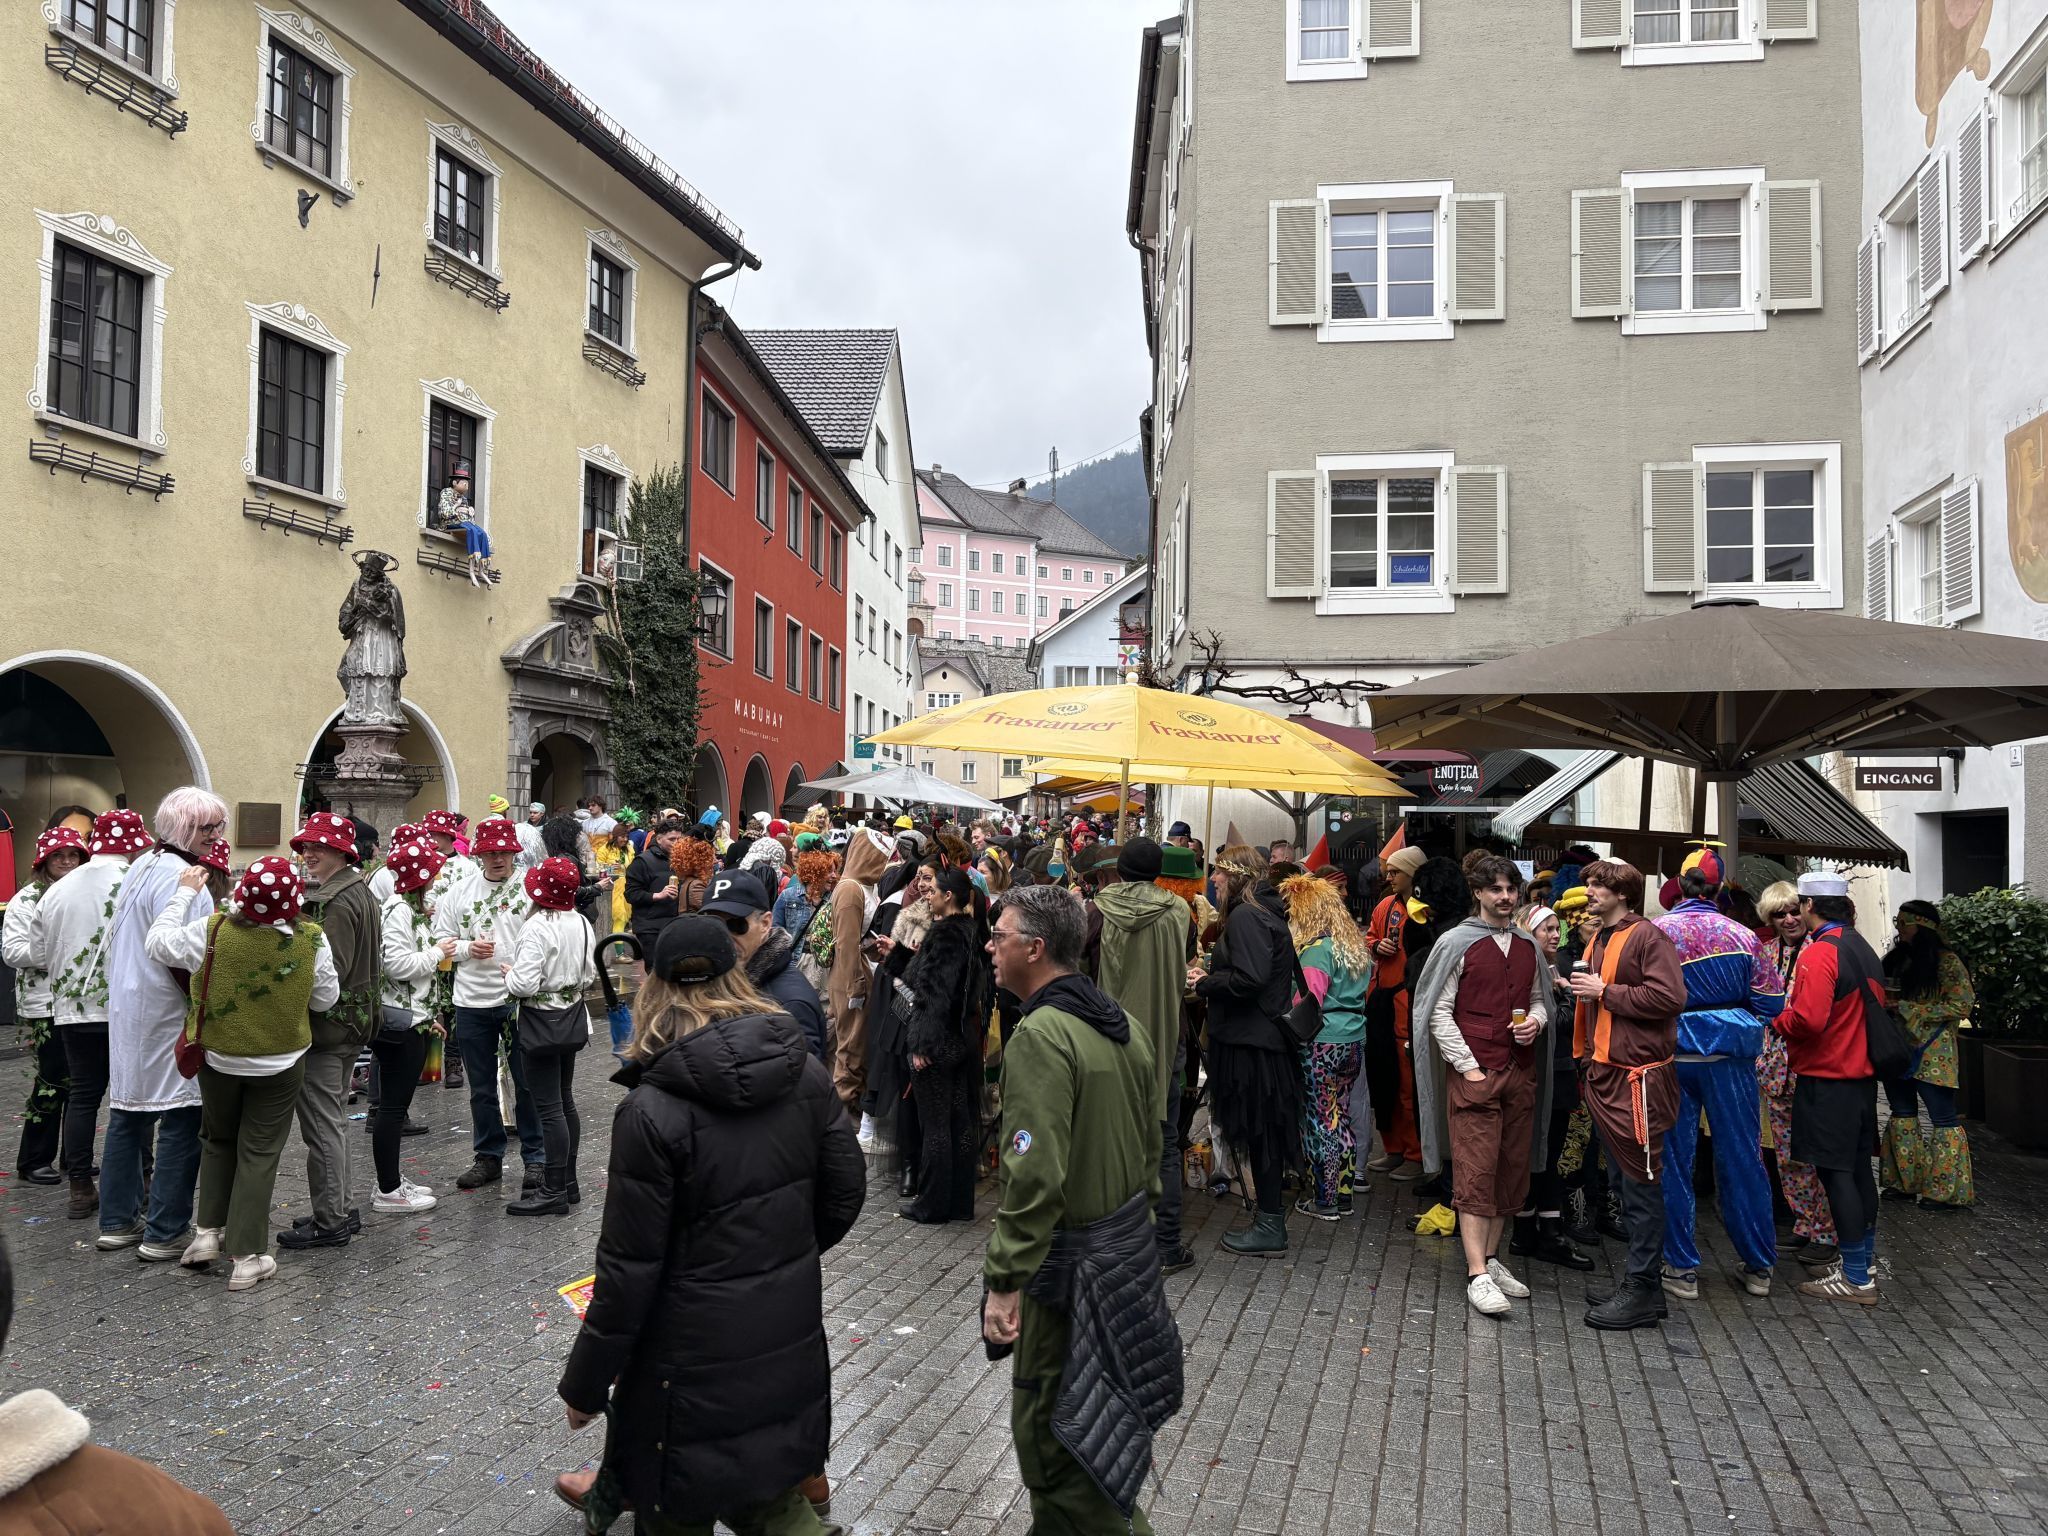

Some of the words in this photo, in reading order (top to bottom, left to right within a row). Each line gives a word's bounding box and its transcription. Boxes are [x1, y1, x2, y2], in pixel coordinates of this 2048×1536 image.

[734, 698, 783, 728] MABUHAY
[983, 711, 1122, 731] frastanzer
[1147, 720, 1281, 745] frastanzer
[1434, 765, 1479, 781] ENOTECA
[1863, 774, 1934, 784] EINGANG
[712, 880, 732, 899] P
